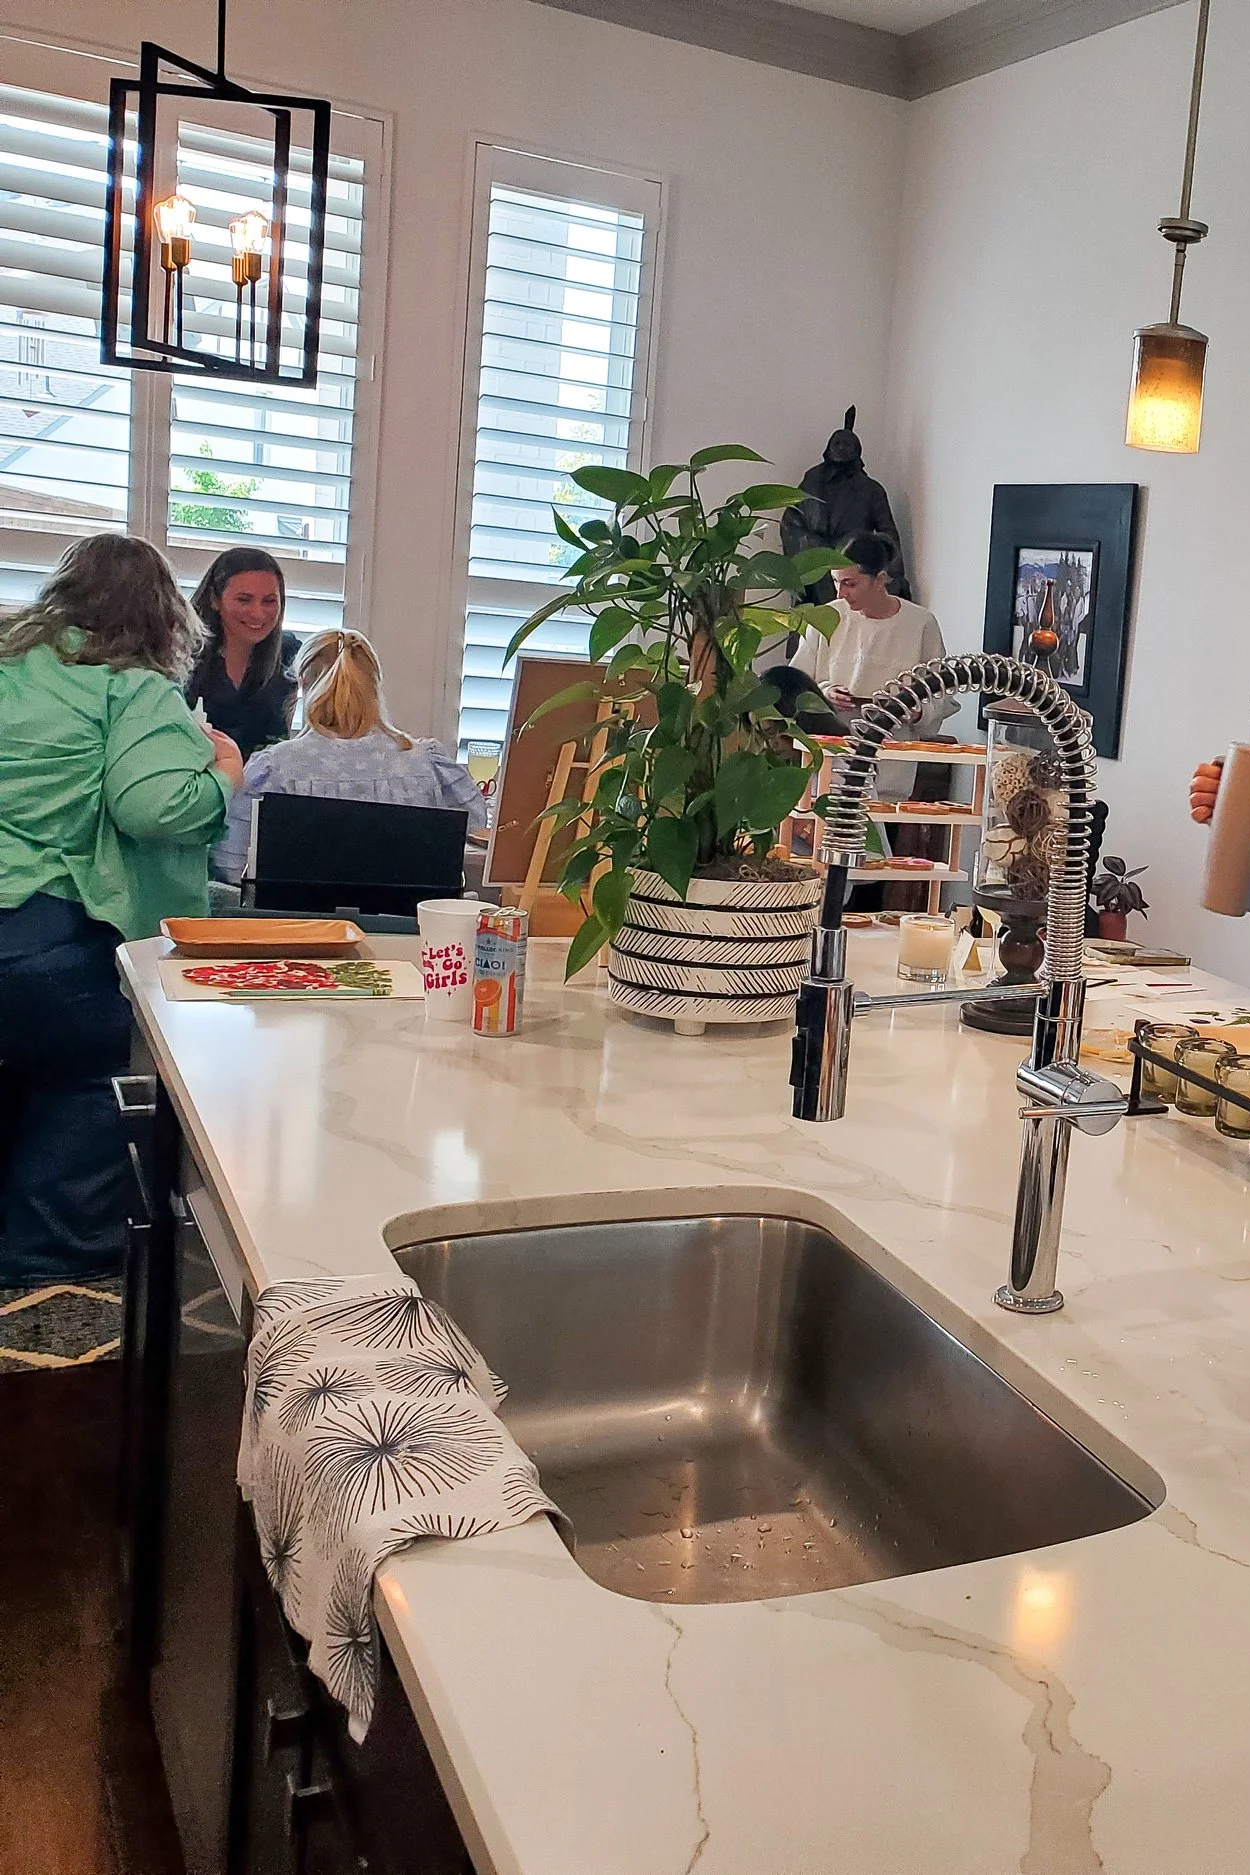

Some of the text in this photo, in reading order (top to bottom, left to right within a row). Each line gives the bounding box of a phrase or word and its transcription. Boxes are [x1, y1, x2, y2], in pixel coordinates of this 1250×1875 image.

[429, 944, 464, 960] Let's
[442, 959, 463, 971] Go
[475, 957, 506, 970] CIAO!
[426, 970, 468, 989] Girls
